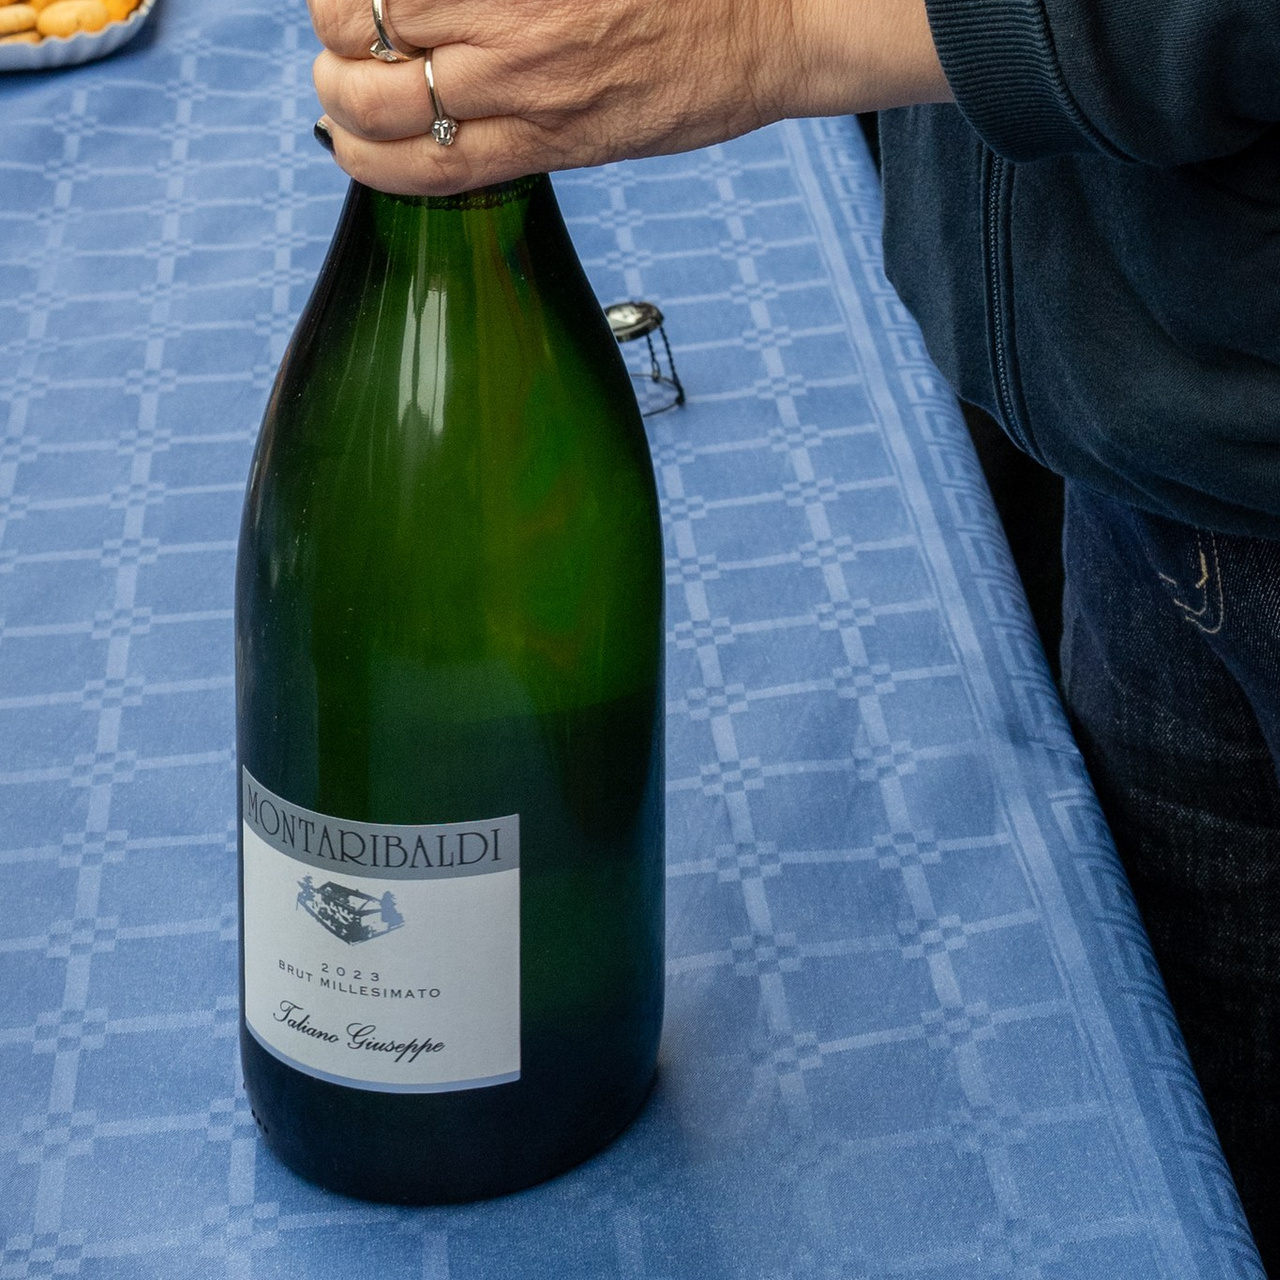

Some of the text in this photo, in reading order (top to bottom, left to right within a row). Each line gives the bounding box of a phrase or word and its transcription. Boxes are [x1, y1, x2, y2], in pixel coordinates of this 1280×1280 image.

[247, 782, 502, 870] MONTARIBALDI
[278, 958, 441, 1000] BRUT MILLESIMATO
[320, 962, 381, 982] 2023
[272, 999, 445, 1064] Taliano Giuseppe
